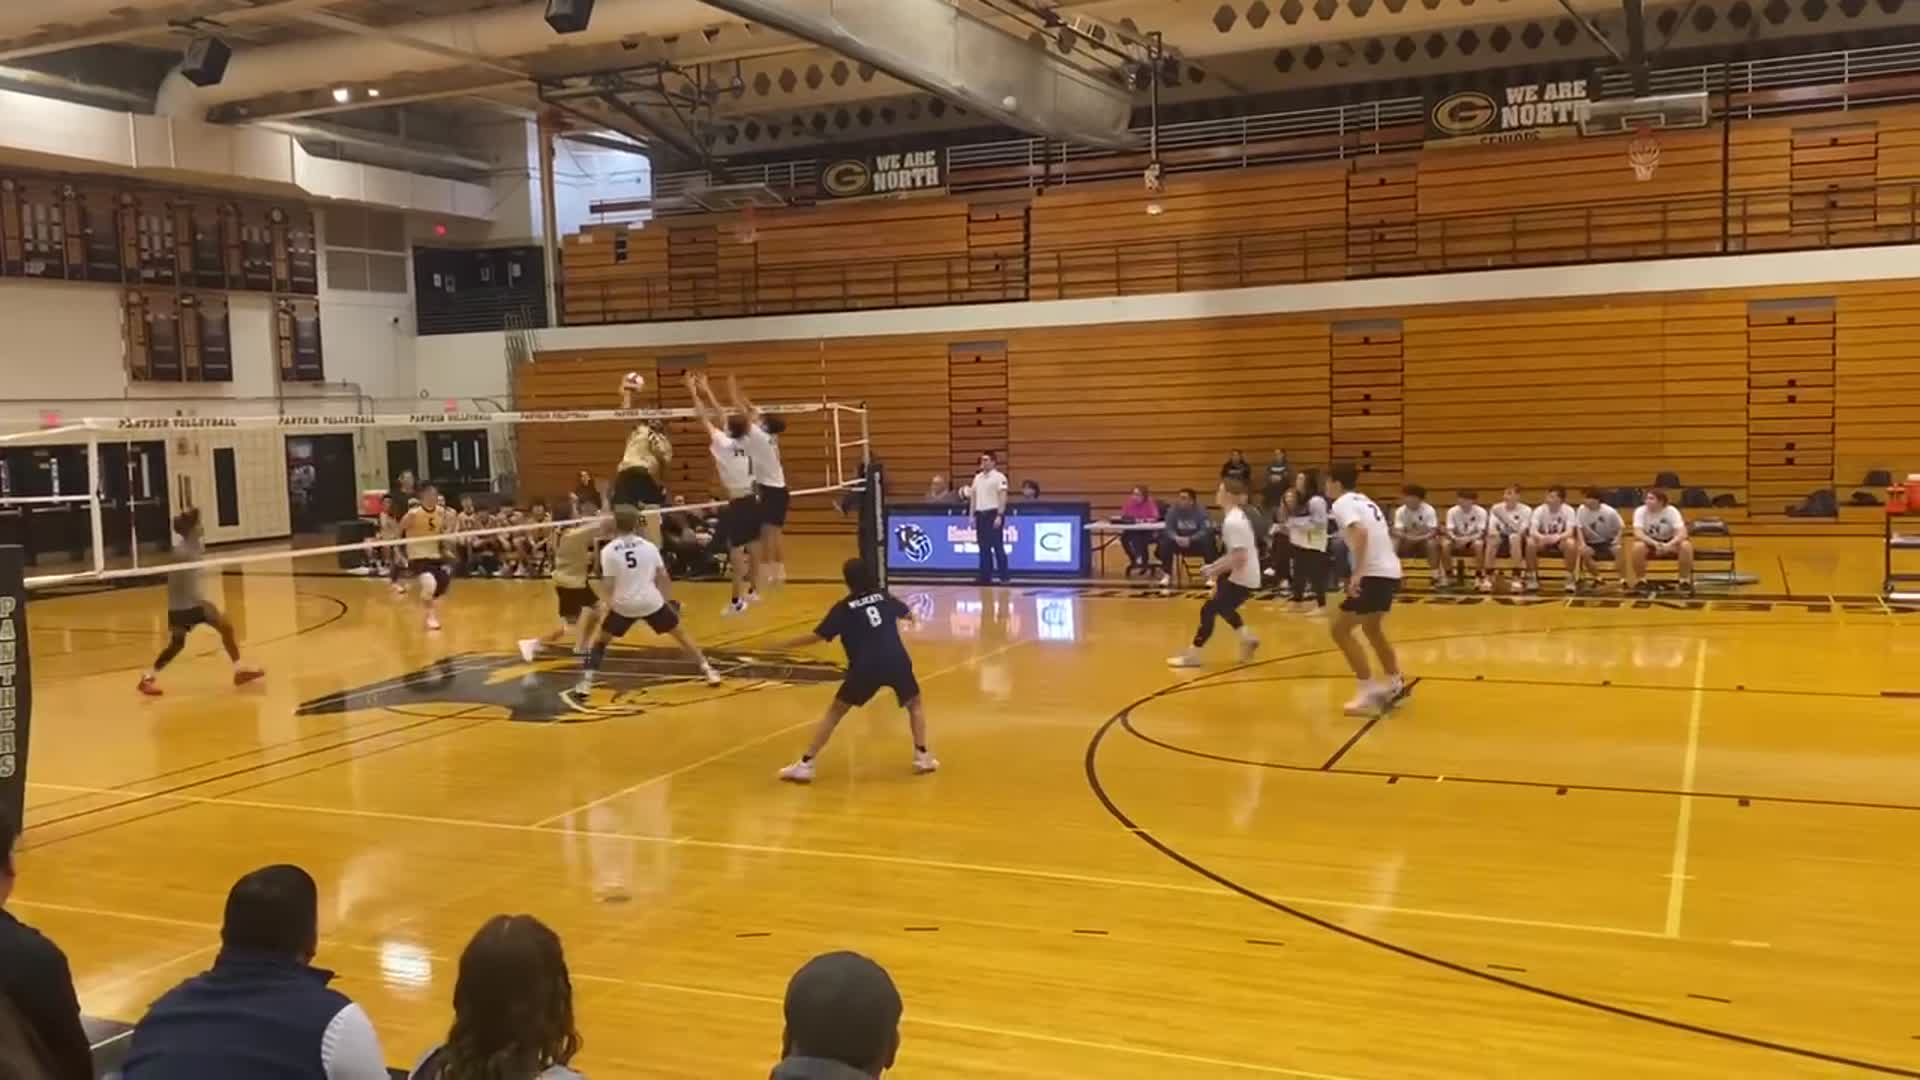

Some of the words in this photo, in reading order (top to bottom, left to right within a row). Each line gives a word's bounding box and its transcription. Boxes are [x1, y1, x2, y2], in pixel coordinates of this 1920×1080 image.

[1505, 84, 1539, 105] WE
[1543, 80, 1588, 100] ARE
[876, 154, 901, 171] WE
[904, 150, 936, 168] ARE
[873, 166, 939, 192] NORTH
[625, 551, 637, 568] 5
[866, 605, 883, 628] 8
